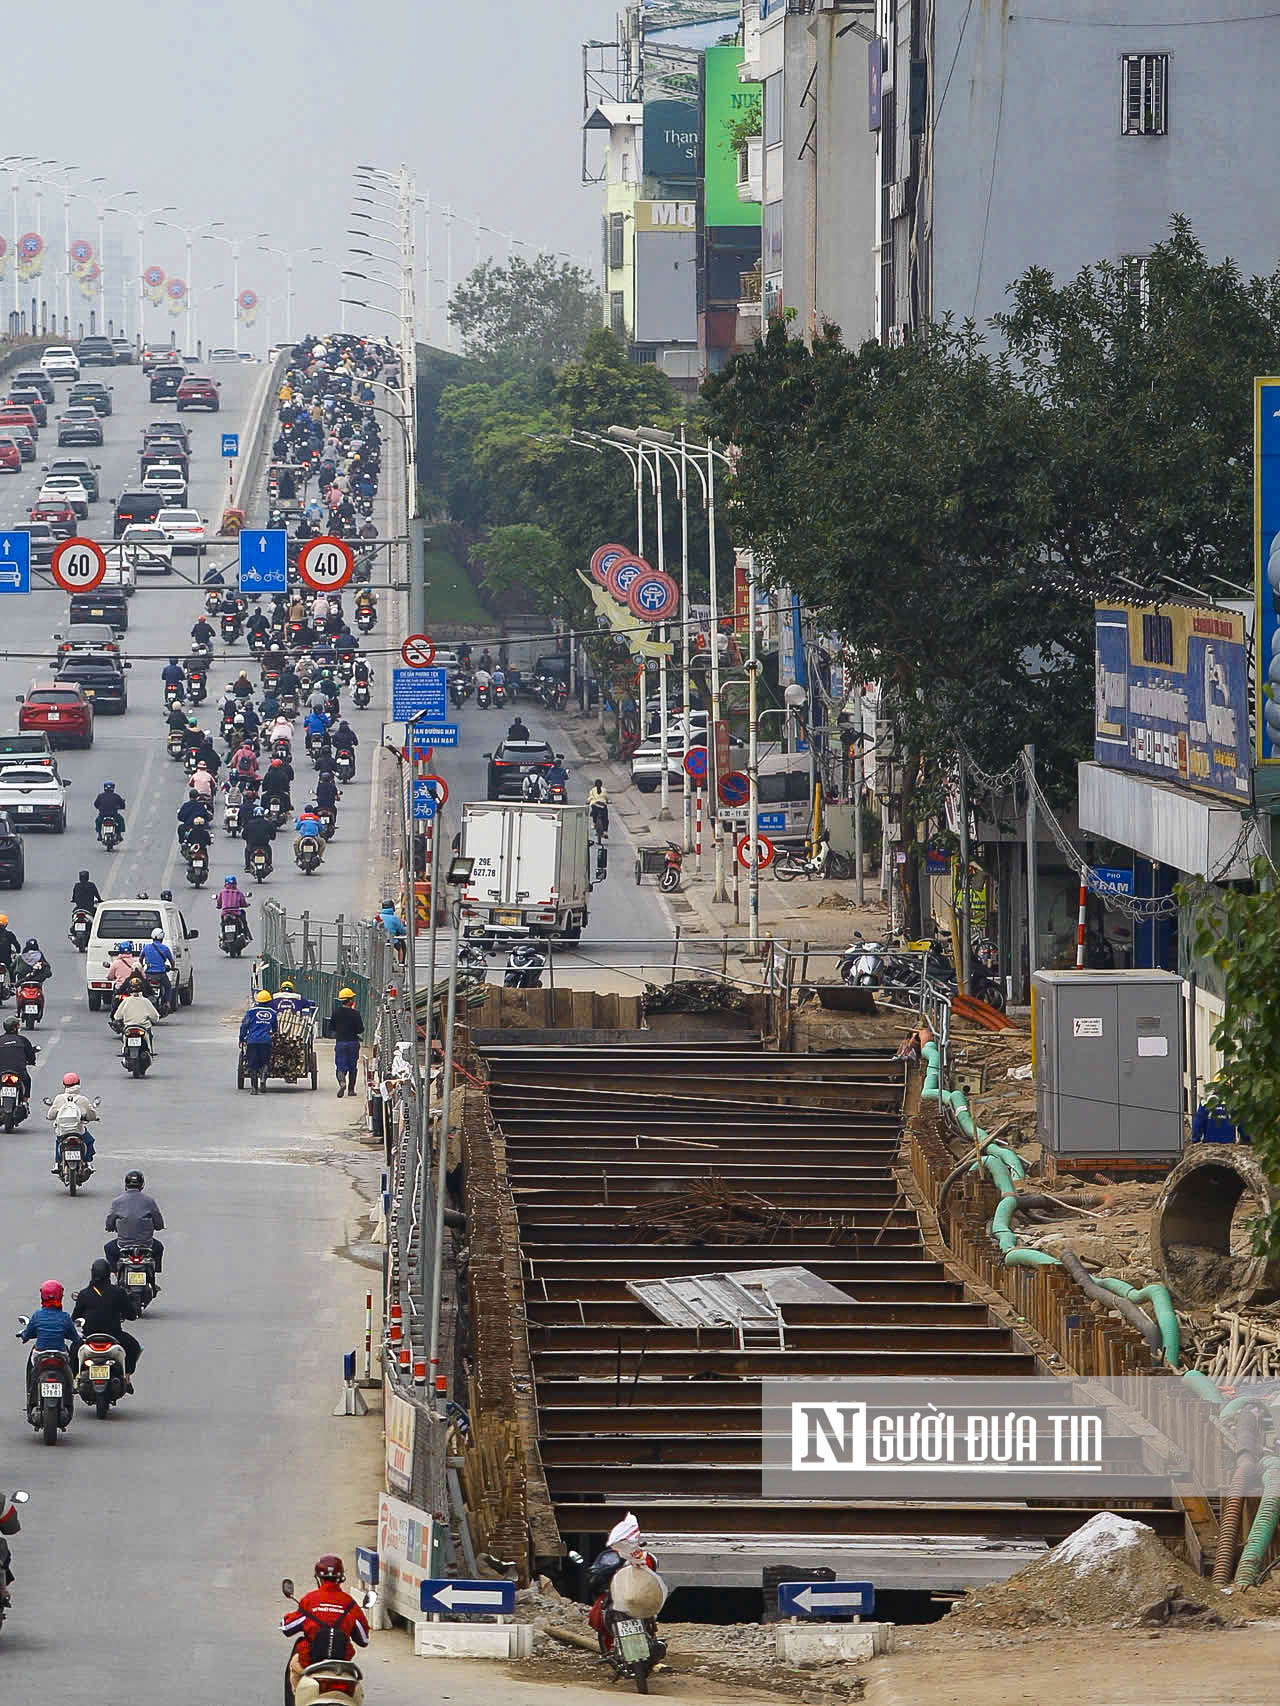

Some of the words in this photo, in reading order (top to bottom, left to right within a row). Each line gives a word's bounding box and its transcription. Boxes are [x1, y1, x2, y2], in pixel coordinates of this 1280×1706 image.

[68, 554, 89, 577] 60
[314, 552, 338, 576] 40
[478, 857, 491, 866] 29E
[473, 868, 496, 877] 627.78
